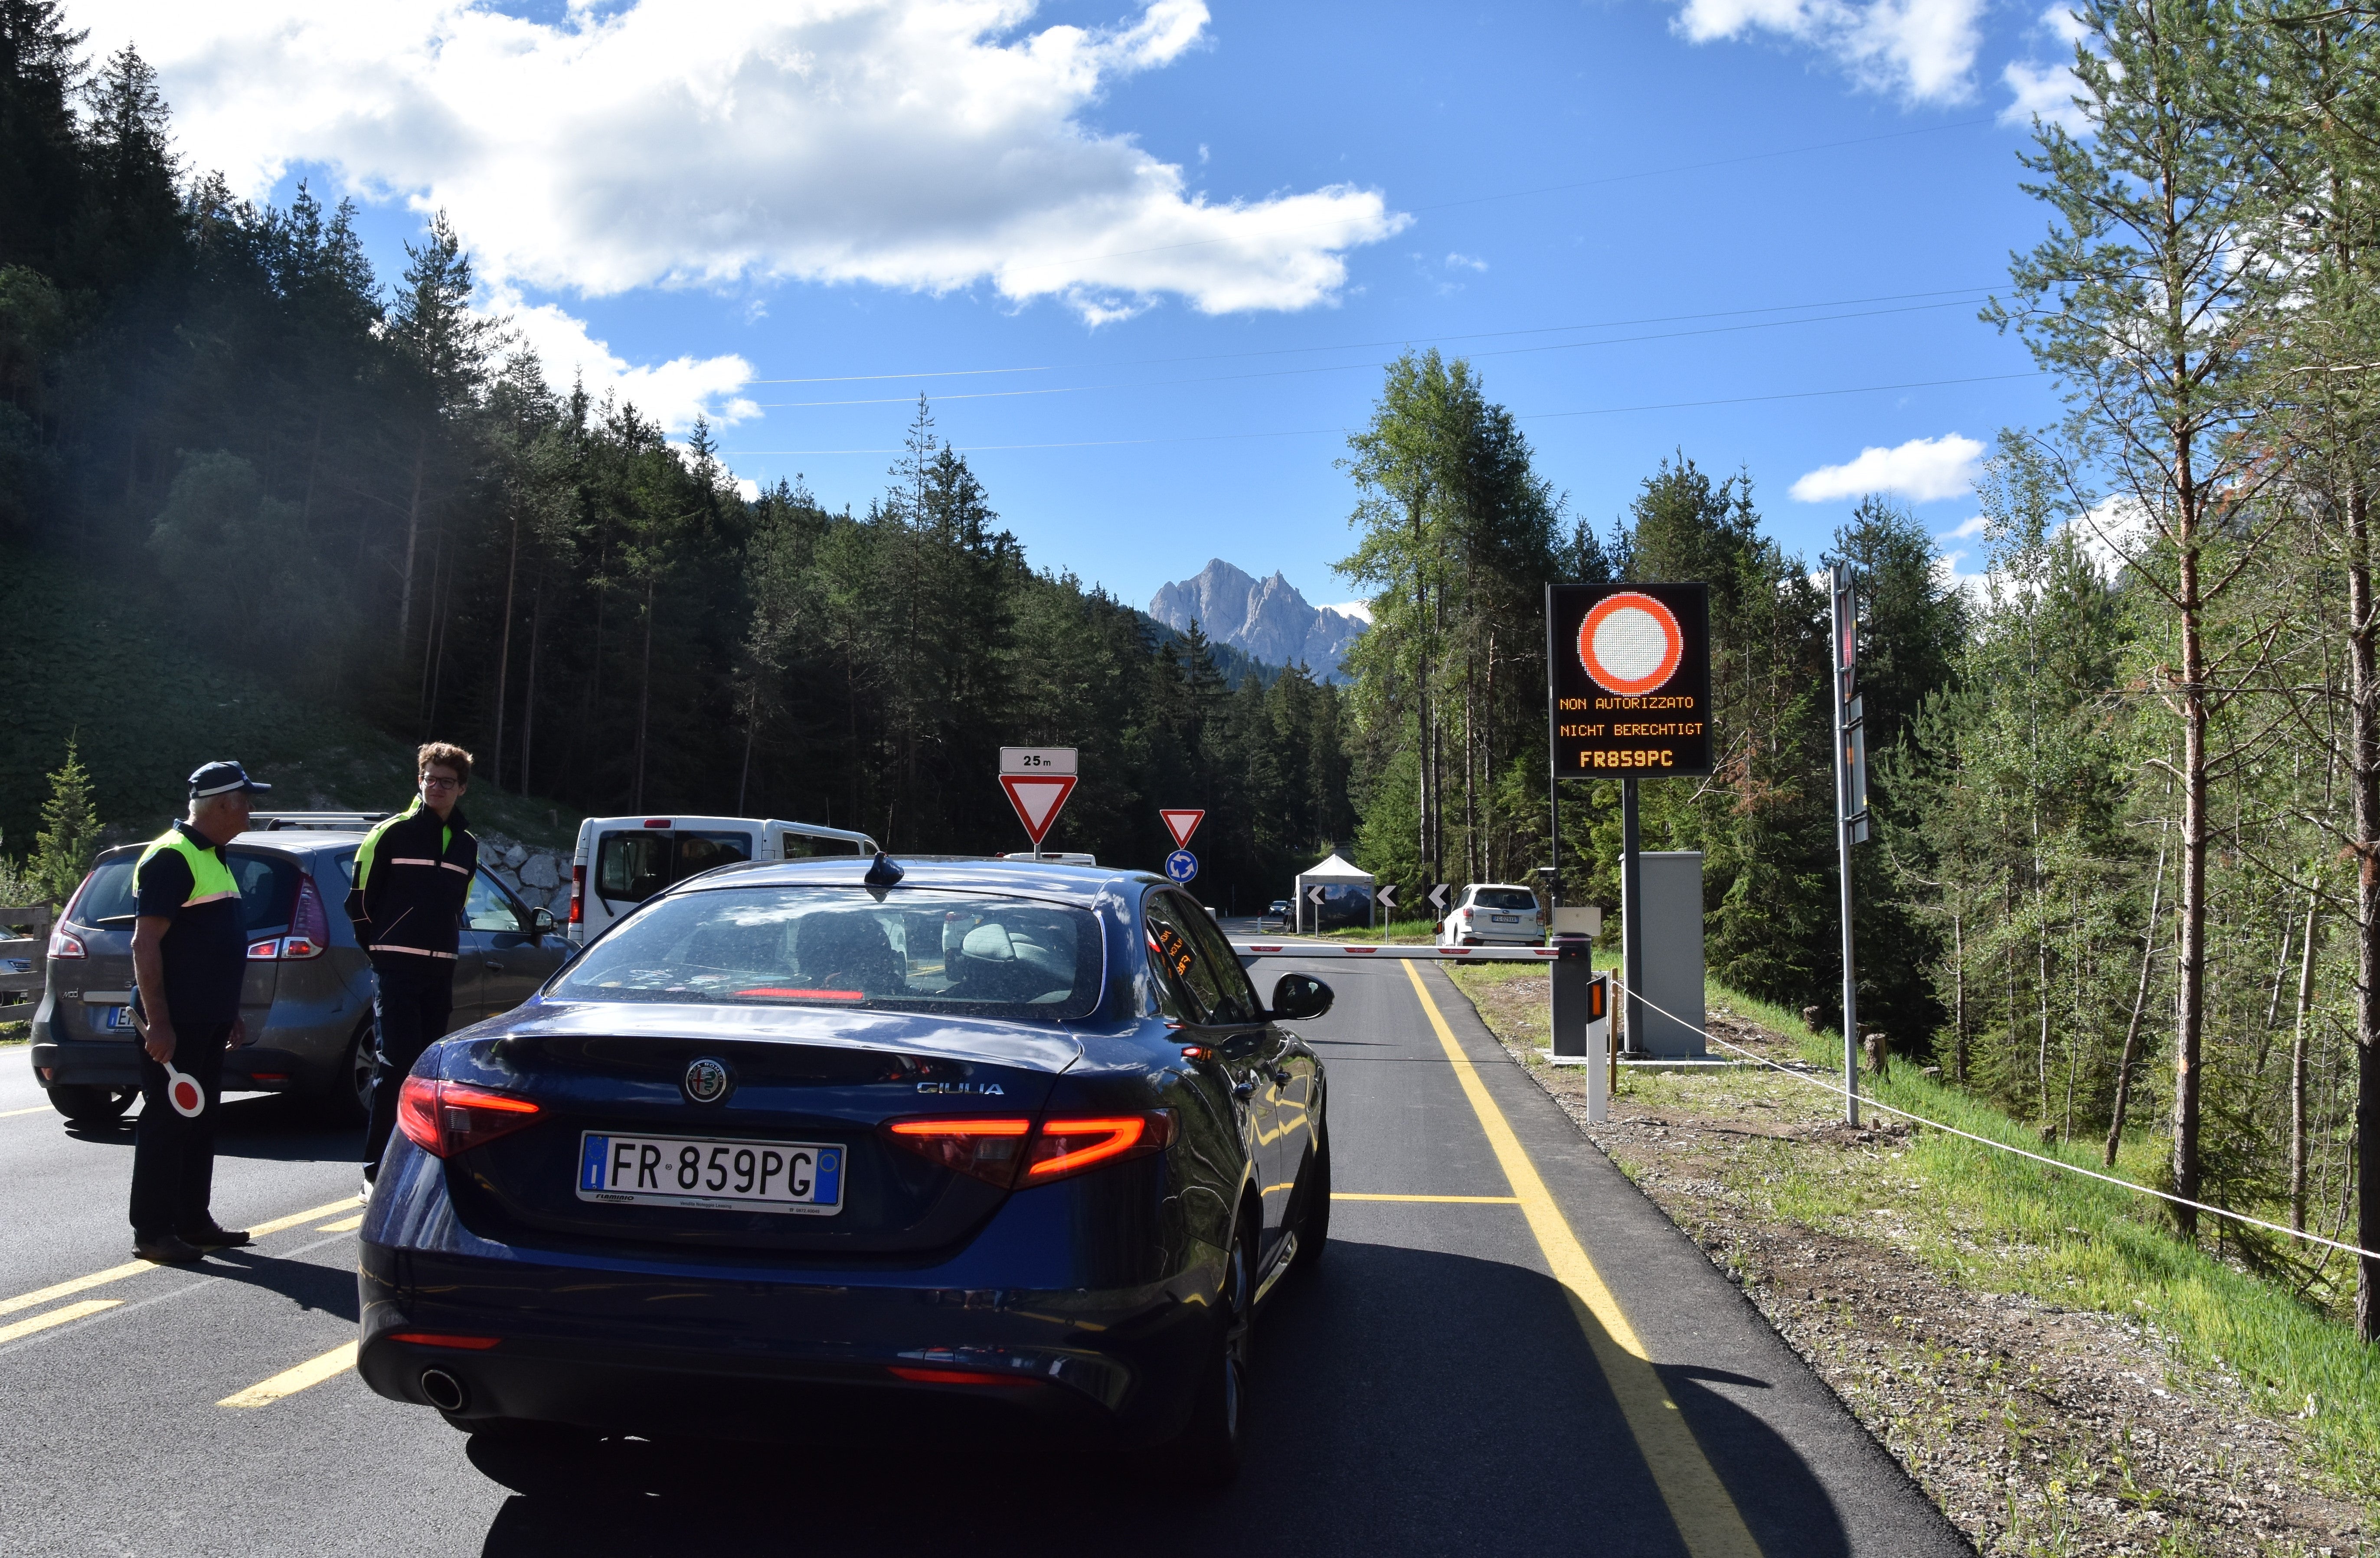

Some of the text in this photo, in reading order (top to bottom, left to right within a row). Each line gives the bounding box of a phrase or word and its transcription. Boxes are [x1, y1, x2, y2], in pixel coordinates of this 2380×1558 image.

[1560, 697, 1693, 710] NON AUTORIZZATO
[1560, 723, 1703, 736] NICHT BERECHTIGT
[1023, 755, 1041, 766] 25
[1580, 750, 1673, 767] FR859PC
[704, 1062, 723, 1082] ROMEO
[917, 1082, 1004, 1095] GIULIA
[611, 1143, 811, 1196] FR 859PG
